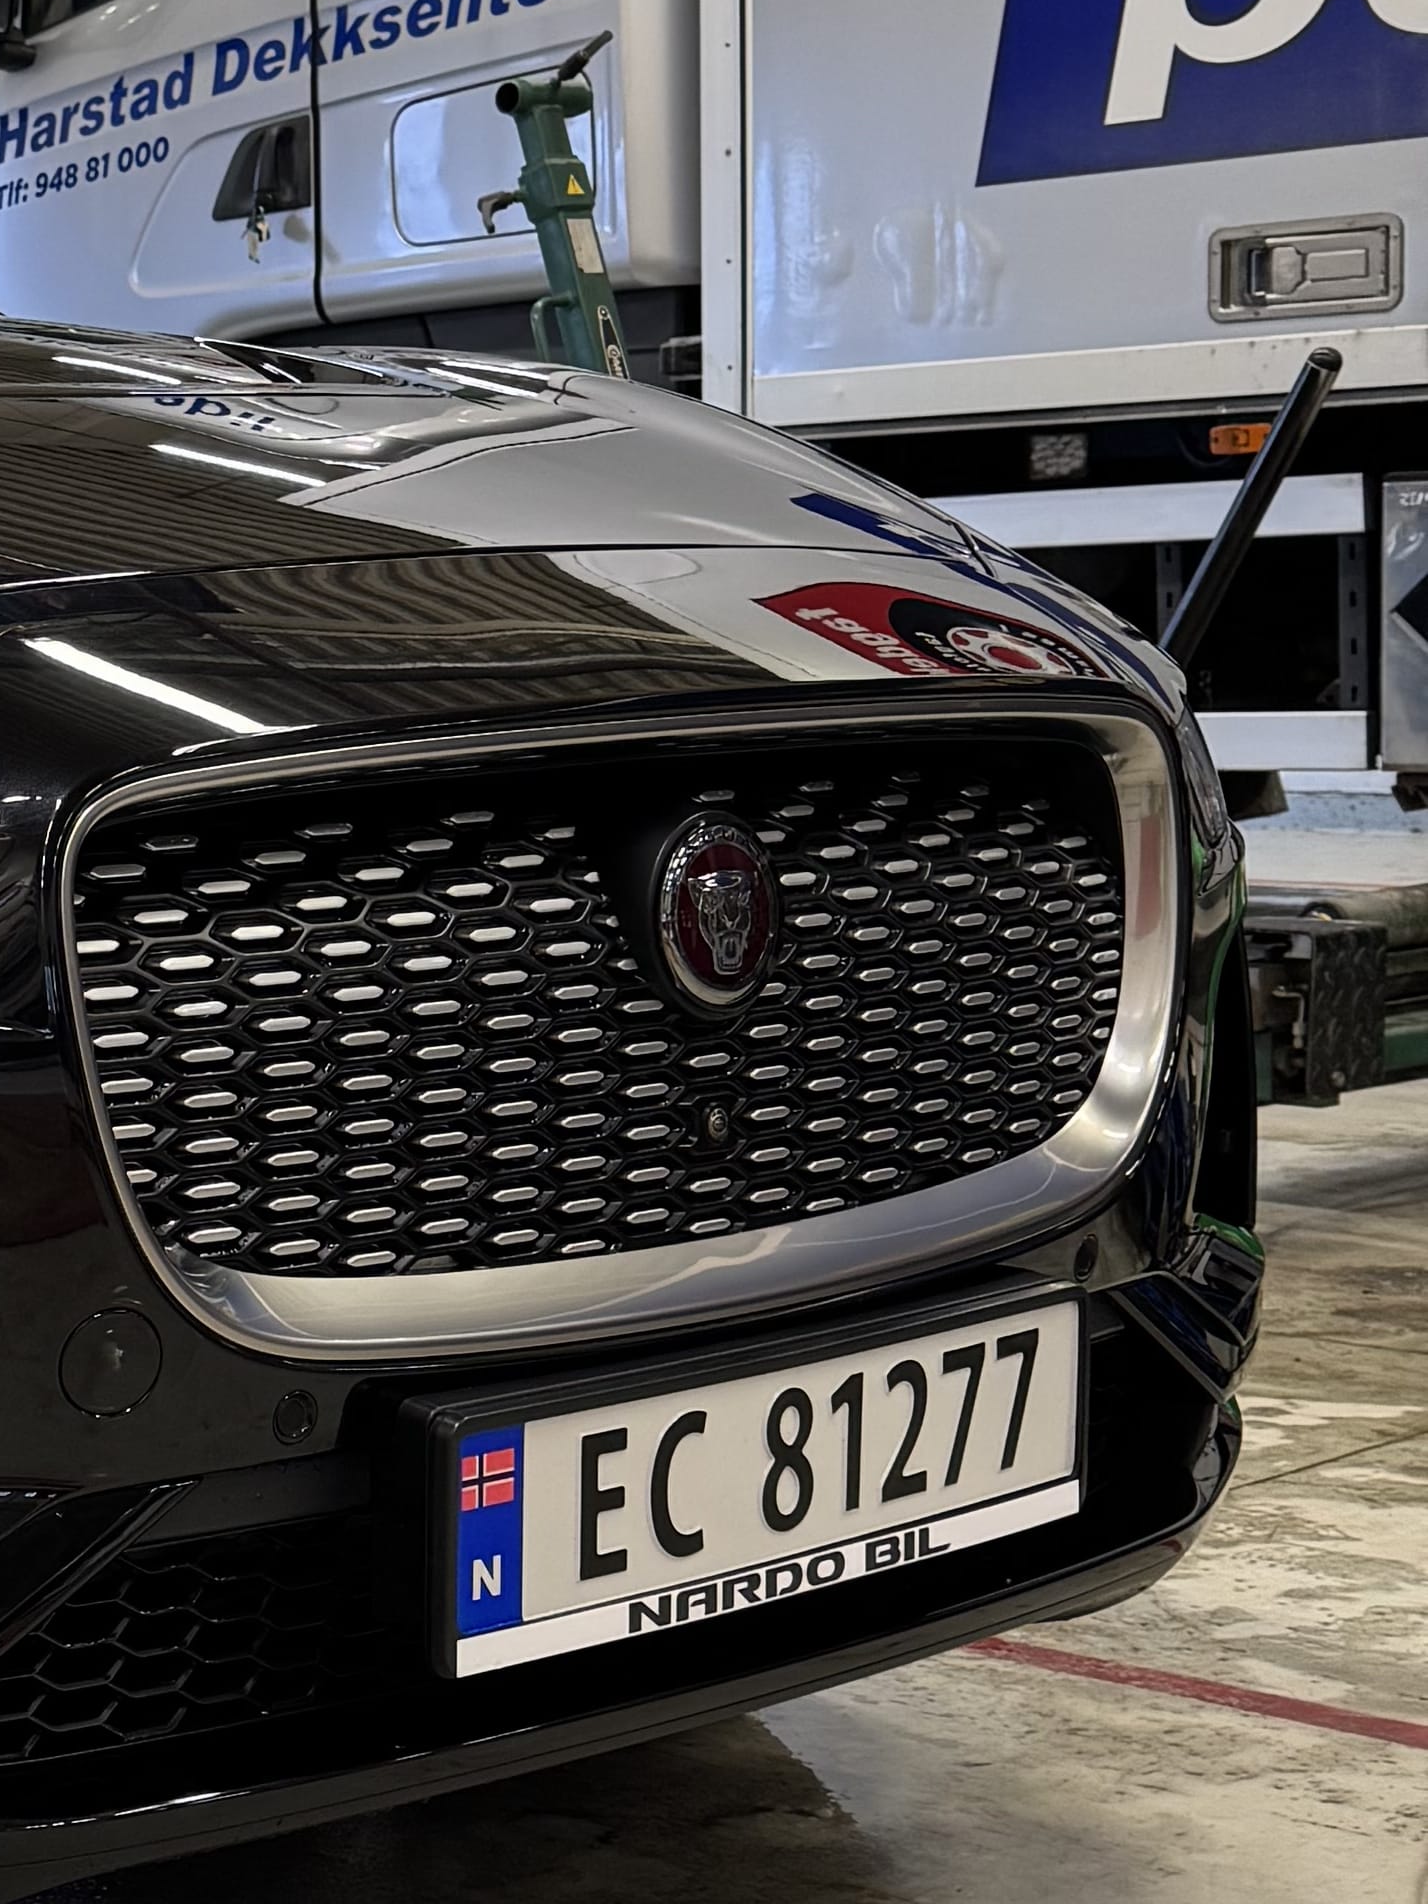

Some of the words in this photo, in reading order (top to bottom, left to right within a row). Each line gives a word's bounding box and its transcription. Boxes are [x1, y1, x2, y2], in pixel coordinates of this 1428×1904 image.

[35, 163, 78, 198] 948
[85, 152, 110, 183] 81
[118, 136, 170, 173] 000
[580, 1410, 708, 1582] EC
[762, 1327, 1040, 1534] 81277
[471, 1555, 502, 1601] N
[628, 1551, 846, 1634] NARDO
[865, 1527, 952, 1572] BIL
